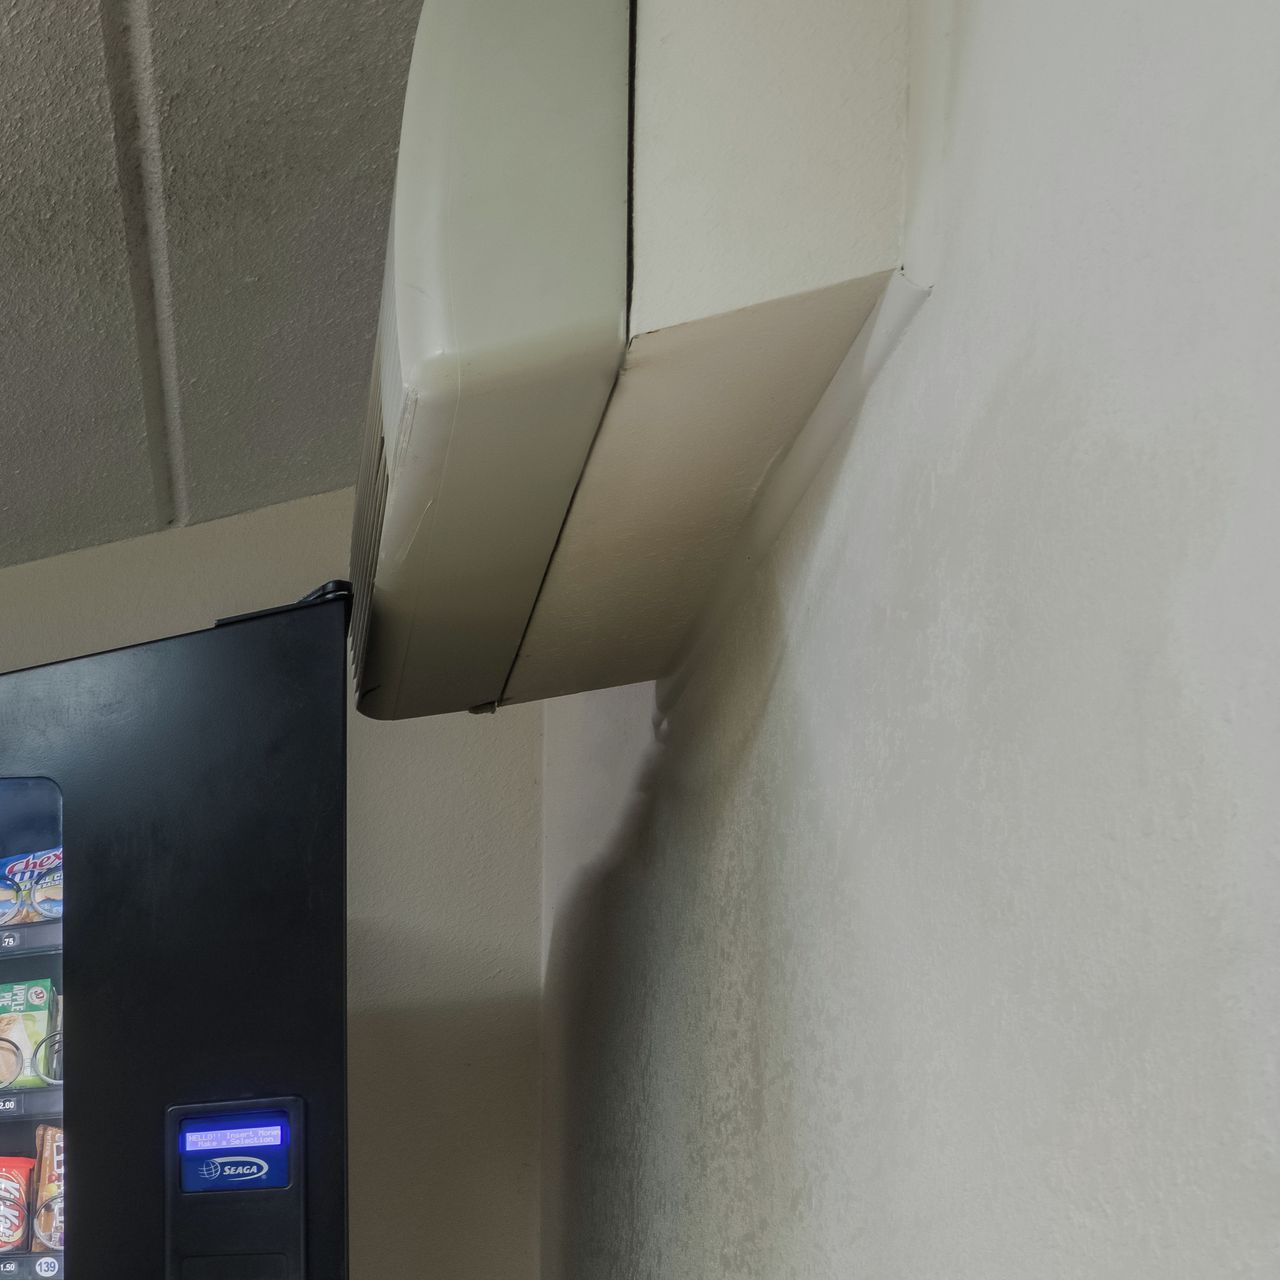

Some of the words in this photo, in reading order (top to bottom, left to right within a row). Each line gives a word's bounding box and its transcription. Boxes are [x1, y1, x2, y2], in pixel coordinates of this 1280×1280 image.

[0, 992, 13, 1006] PIE
[11, 985, 25, 1011] APPLE
[230, 1136, 275, 1146] Selection
[223, 1165, 258, 1176] SEAGA
[0, 1263, 15, 1272] 1.50
[38, 1261, 56, 1273] 139
